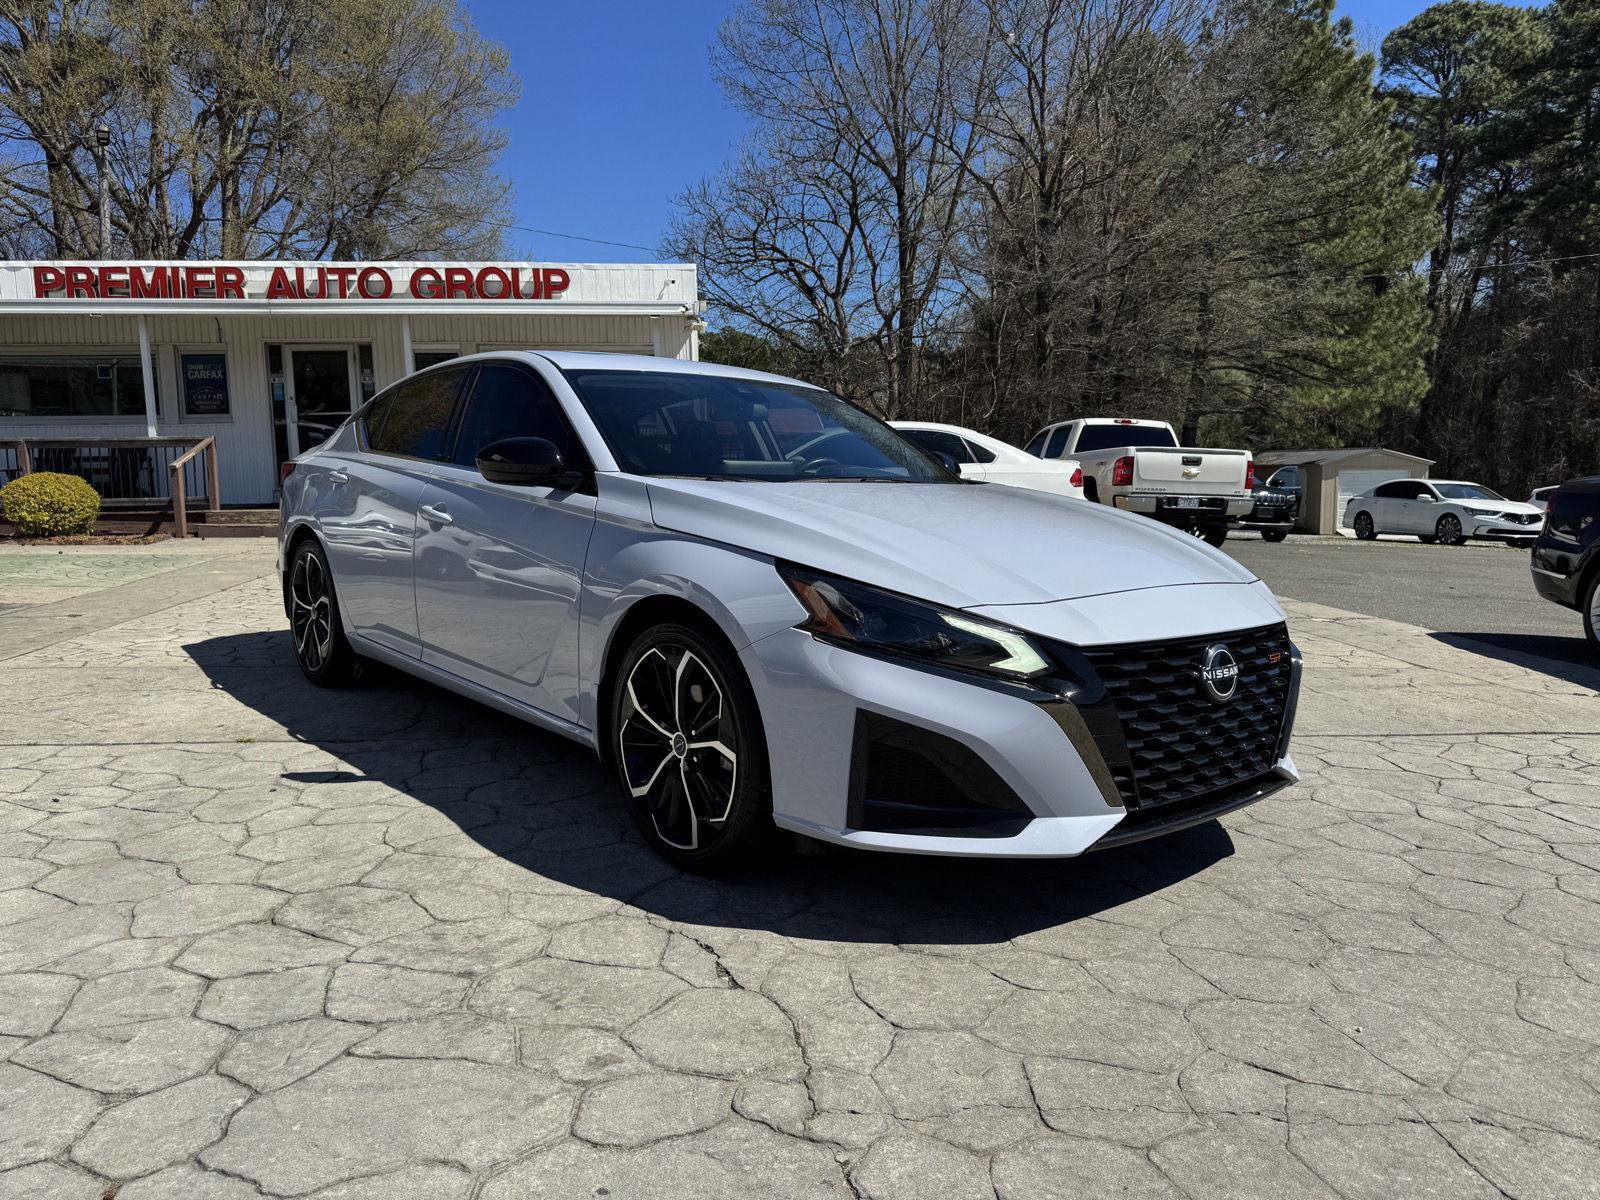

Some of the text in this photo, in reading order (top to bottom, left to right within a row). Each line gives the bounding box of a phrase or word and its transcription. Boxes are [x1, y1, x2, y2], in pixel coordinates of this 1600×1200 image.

[33, 266, 571, 299] PREMIER AUTO GROUP
[188, 370, 223, 379] CARFAX
[1203, 665, 1239, 680] NISSAN
